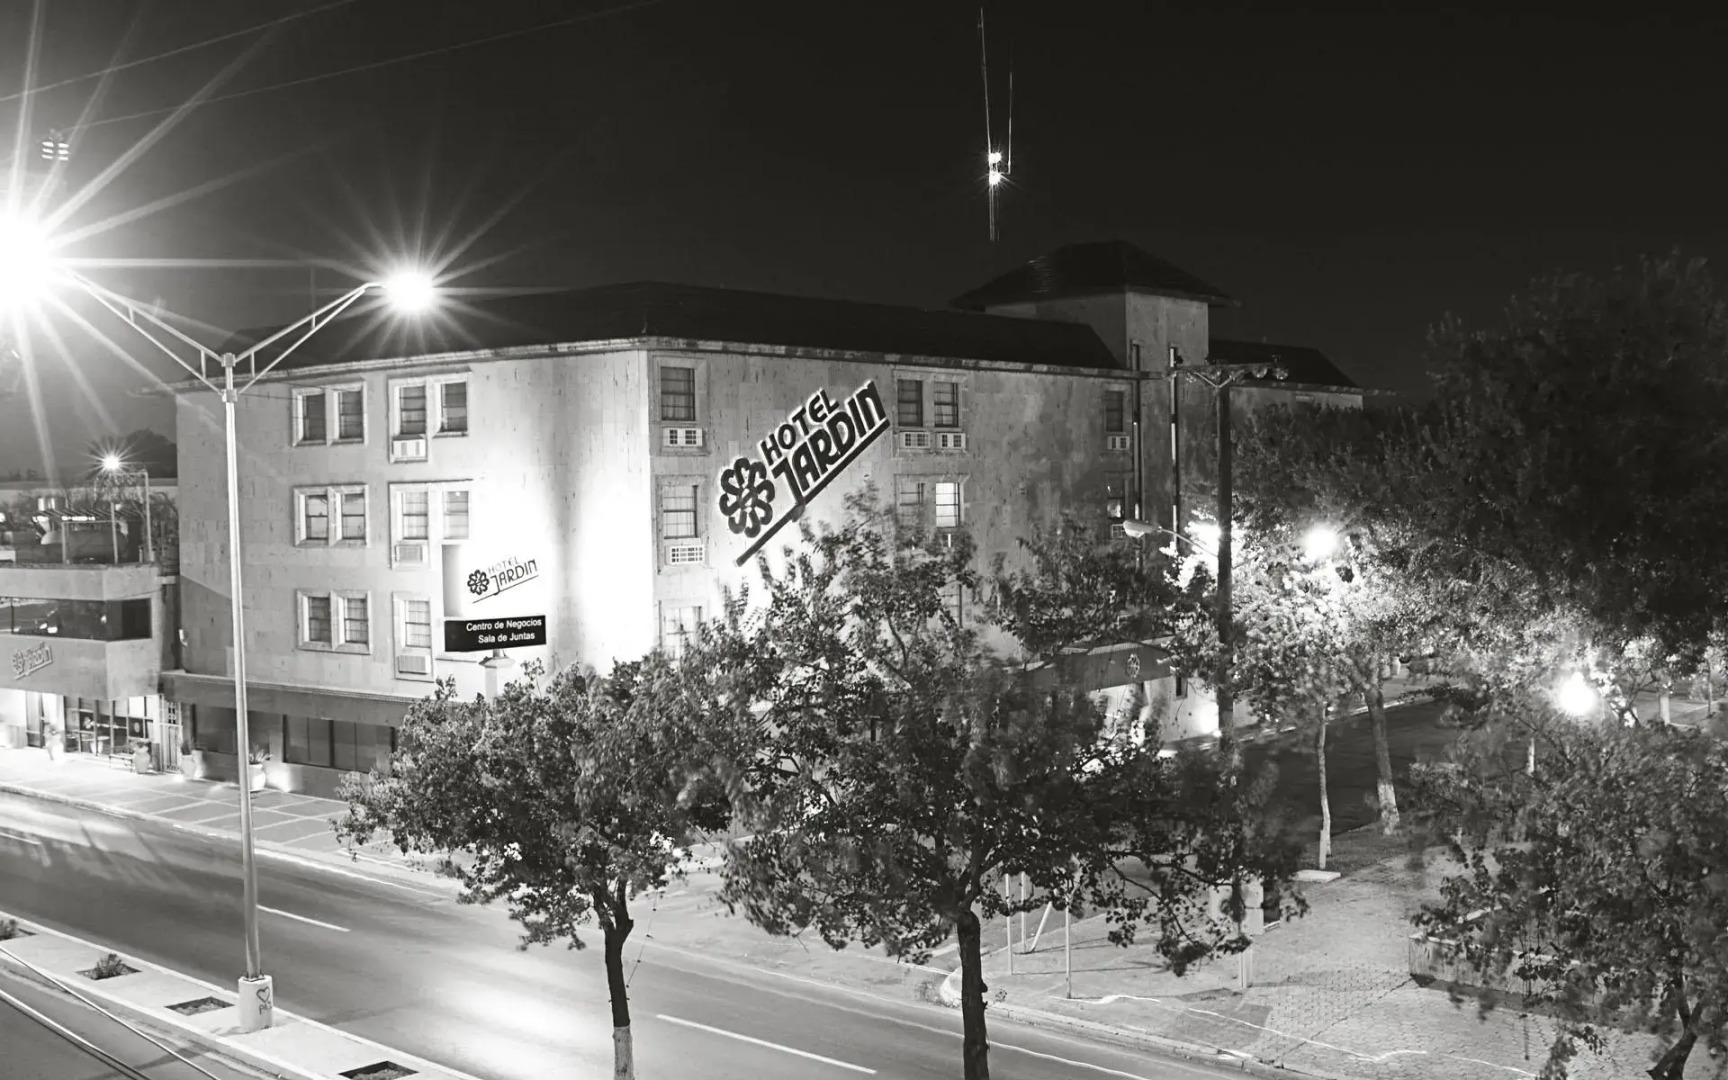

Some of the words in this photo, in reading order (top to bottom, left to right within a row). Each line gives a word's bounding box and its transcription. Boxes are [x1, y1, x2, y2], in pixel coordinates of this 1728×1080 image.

[758, 388, 840, 467] HOTEL
[770, 380, 888, 522] JARDIN
[488, 556, 519, 575] HOTEL
[490, 559, 538, 595] JARDIN
[466, 622, 492, 631] Centro
[494, 621, 504, 629] de
[506, 619, 542, 630] Negocios
[478, 634, 495, 643] Sala
[497, 633, 508, 642] de
[509, 632, 535, 641] Juntas
